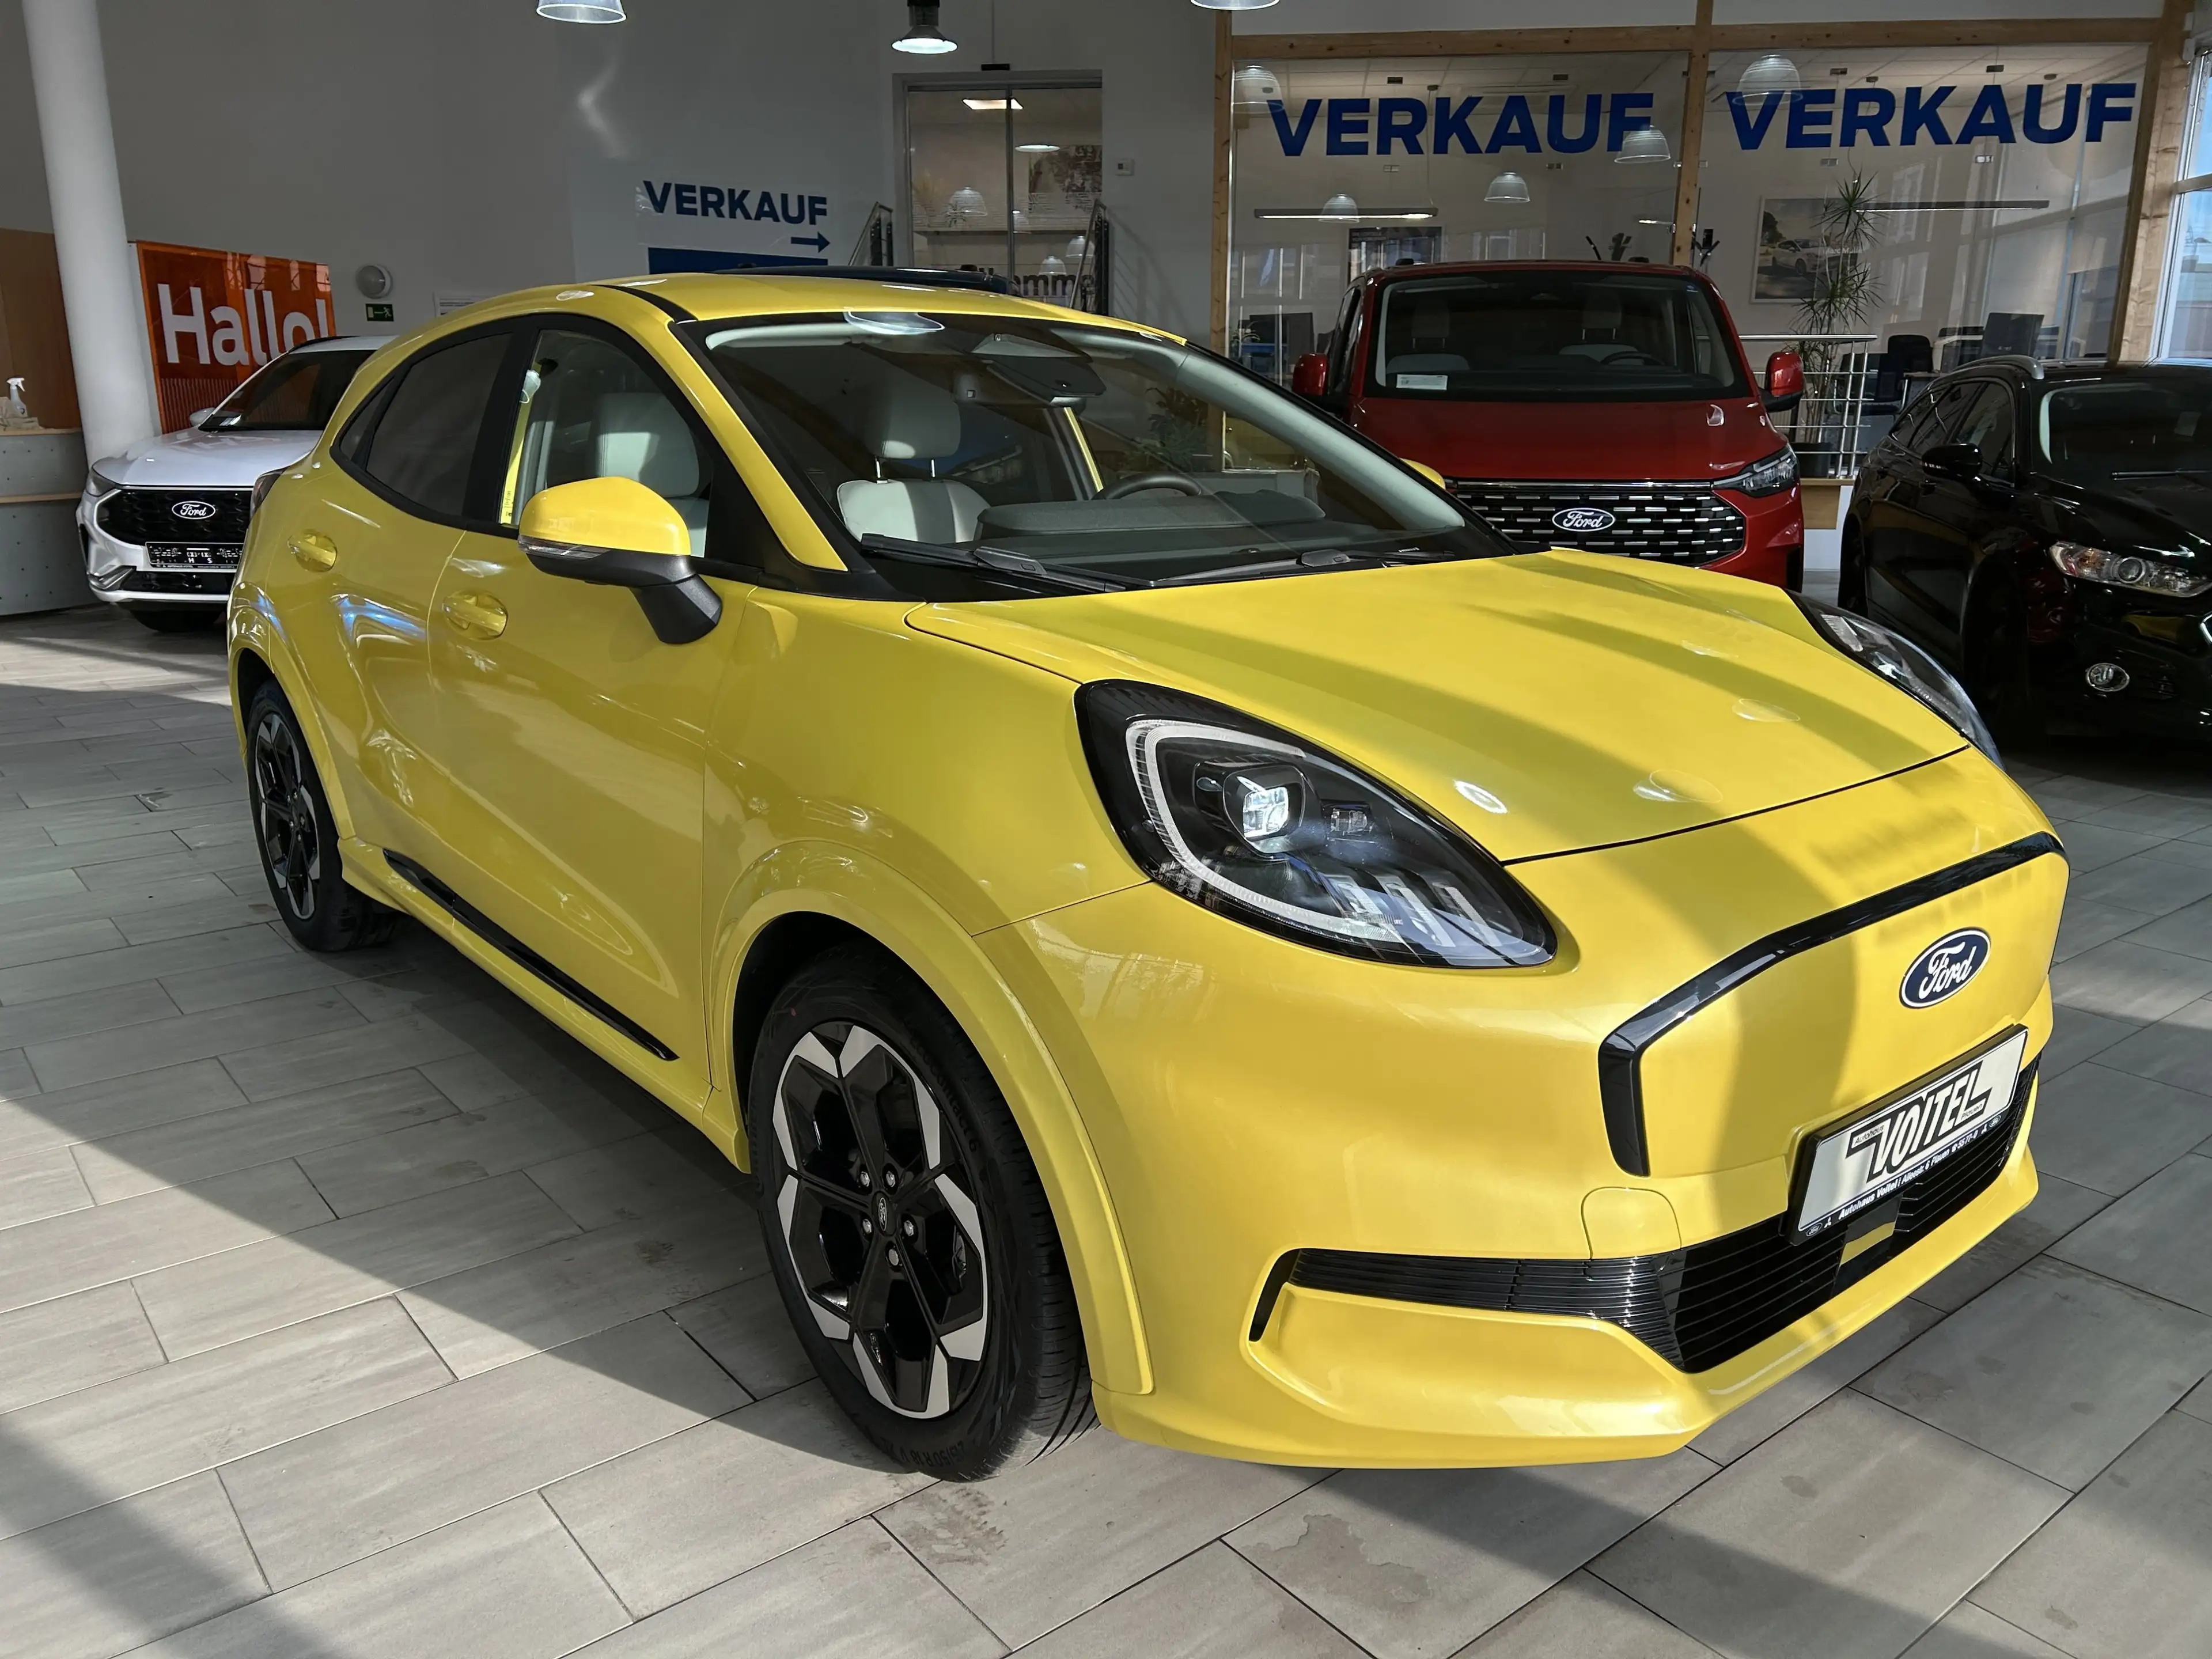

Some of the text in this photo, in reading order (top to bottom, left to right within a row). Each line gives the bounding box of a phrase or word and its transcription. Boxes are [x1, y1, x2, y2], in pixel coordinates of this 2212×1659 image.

[1267, 92, 1654, 157] VERKAUF
[1726, 82, 2137, 150] VERKAUF
[643, 180, 827, 225] VERKAUF
[180, 503, 207, 516] Ford
[1563, 511, 1604, 527] Ford
[1919, 941, 1977, 999] Ford
[1851, 1066, 1986, 1178] VOITEL
[1854, 1124, 1885, 1145] Autohaus
[1960, 1103, 1983, 1121] Plauen
[1838, 1192, 1876, 1220] Autohaus
[1877, 1178, 1898, 1203] Voitel
[1925, 1161, 1930, 1171] 6
[1931, 1149, 1950, 1166] Plauen
